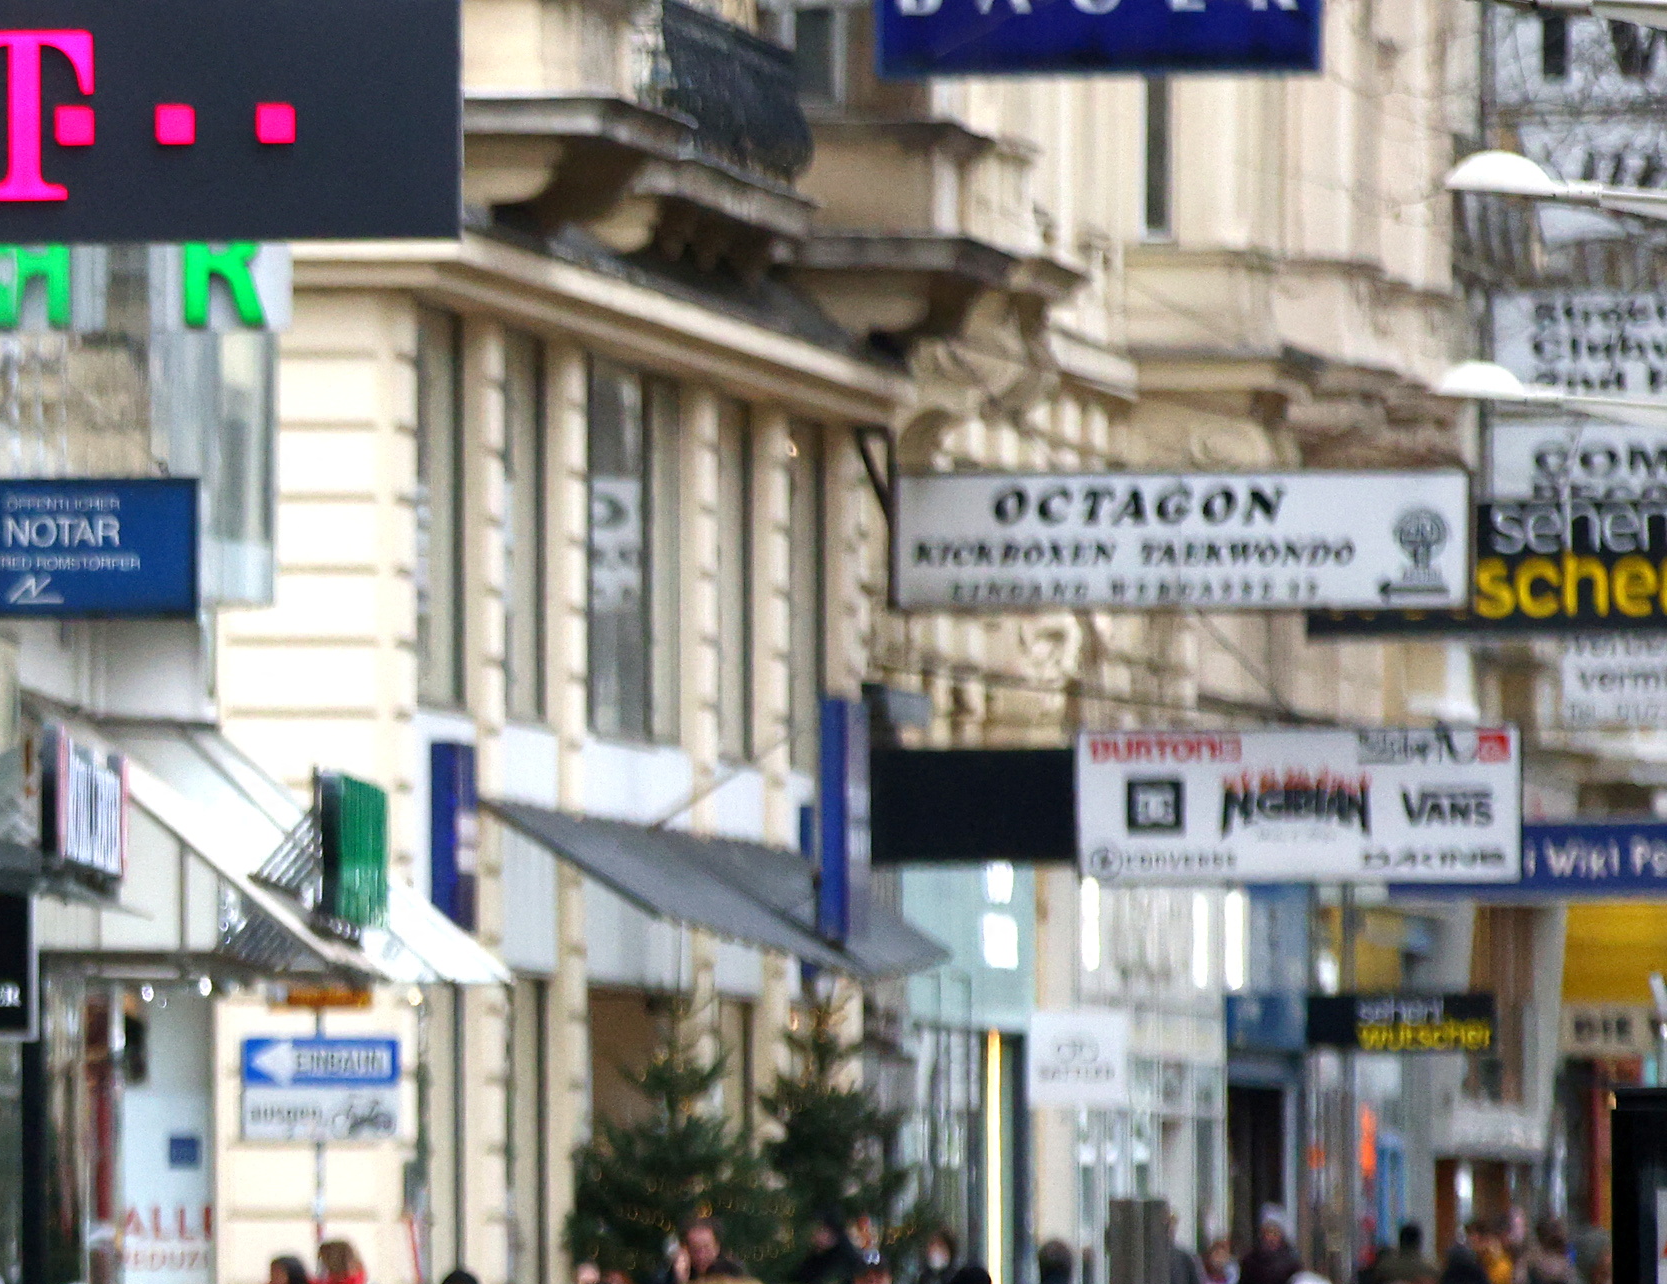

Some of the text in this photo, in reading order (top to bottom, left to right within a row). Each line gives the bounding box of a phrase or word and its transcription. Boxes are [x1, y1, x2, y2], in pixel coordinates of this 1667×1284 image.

[992, 484, 1286, 527] OCTAGON
[4, 515, 120, 548] NOTAR
[913, 539, 1358, 568] KICKBOXEN TAEKWONDO
[1090, 737, 1223, 763] BURTON
[1400, 787, 1494, 828] VANS
